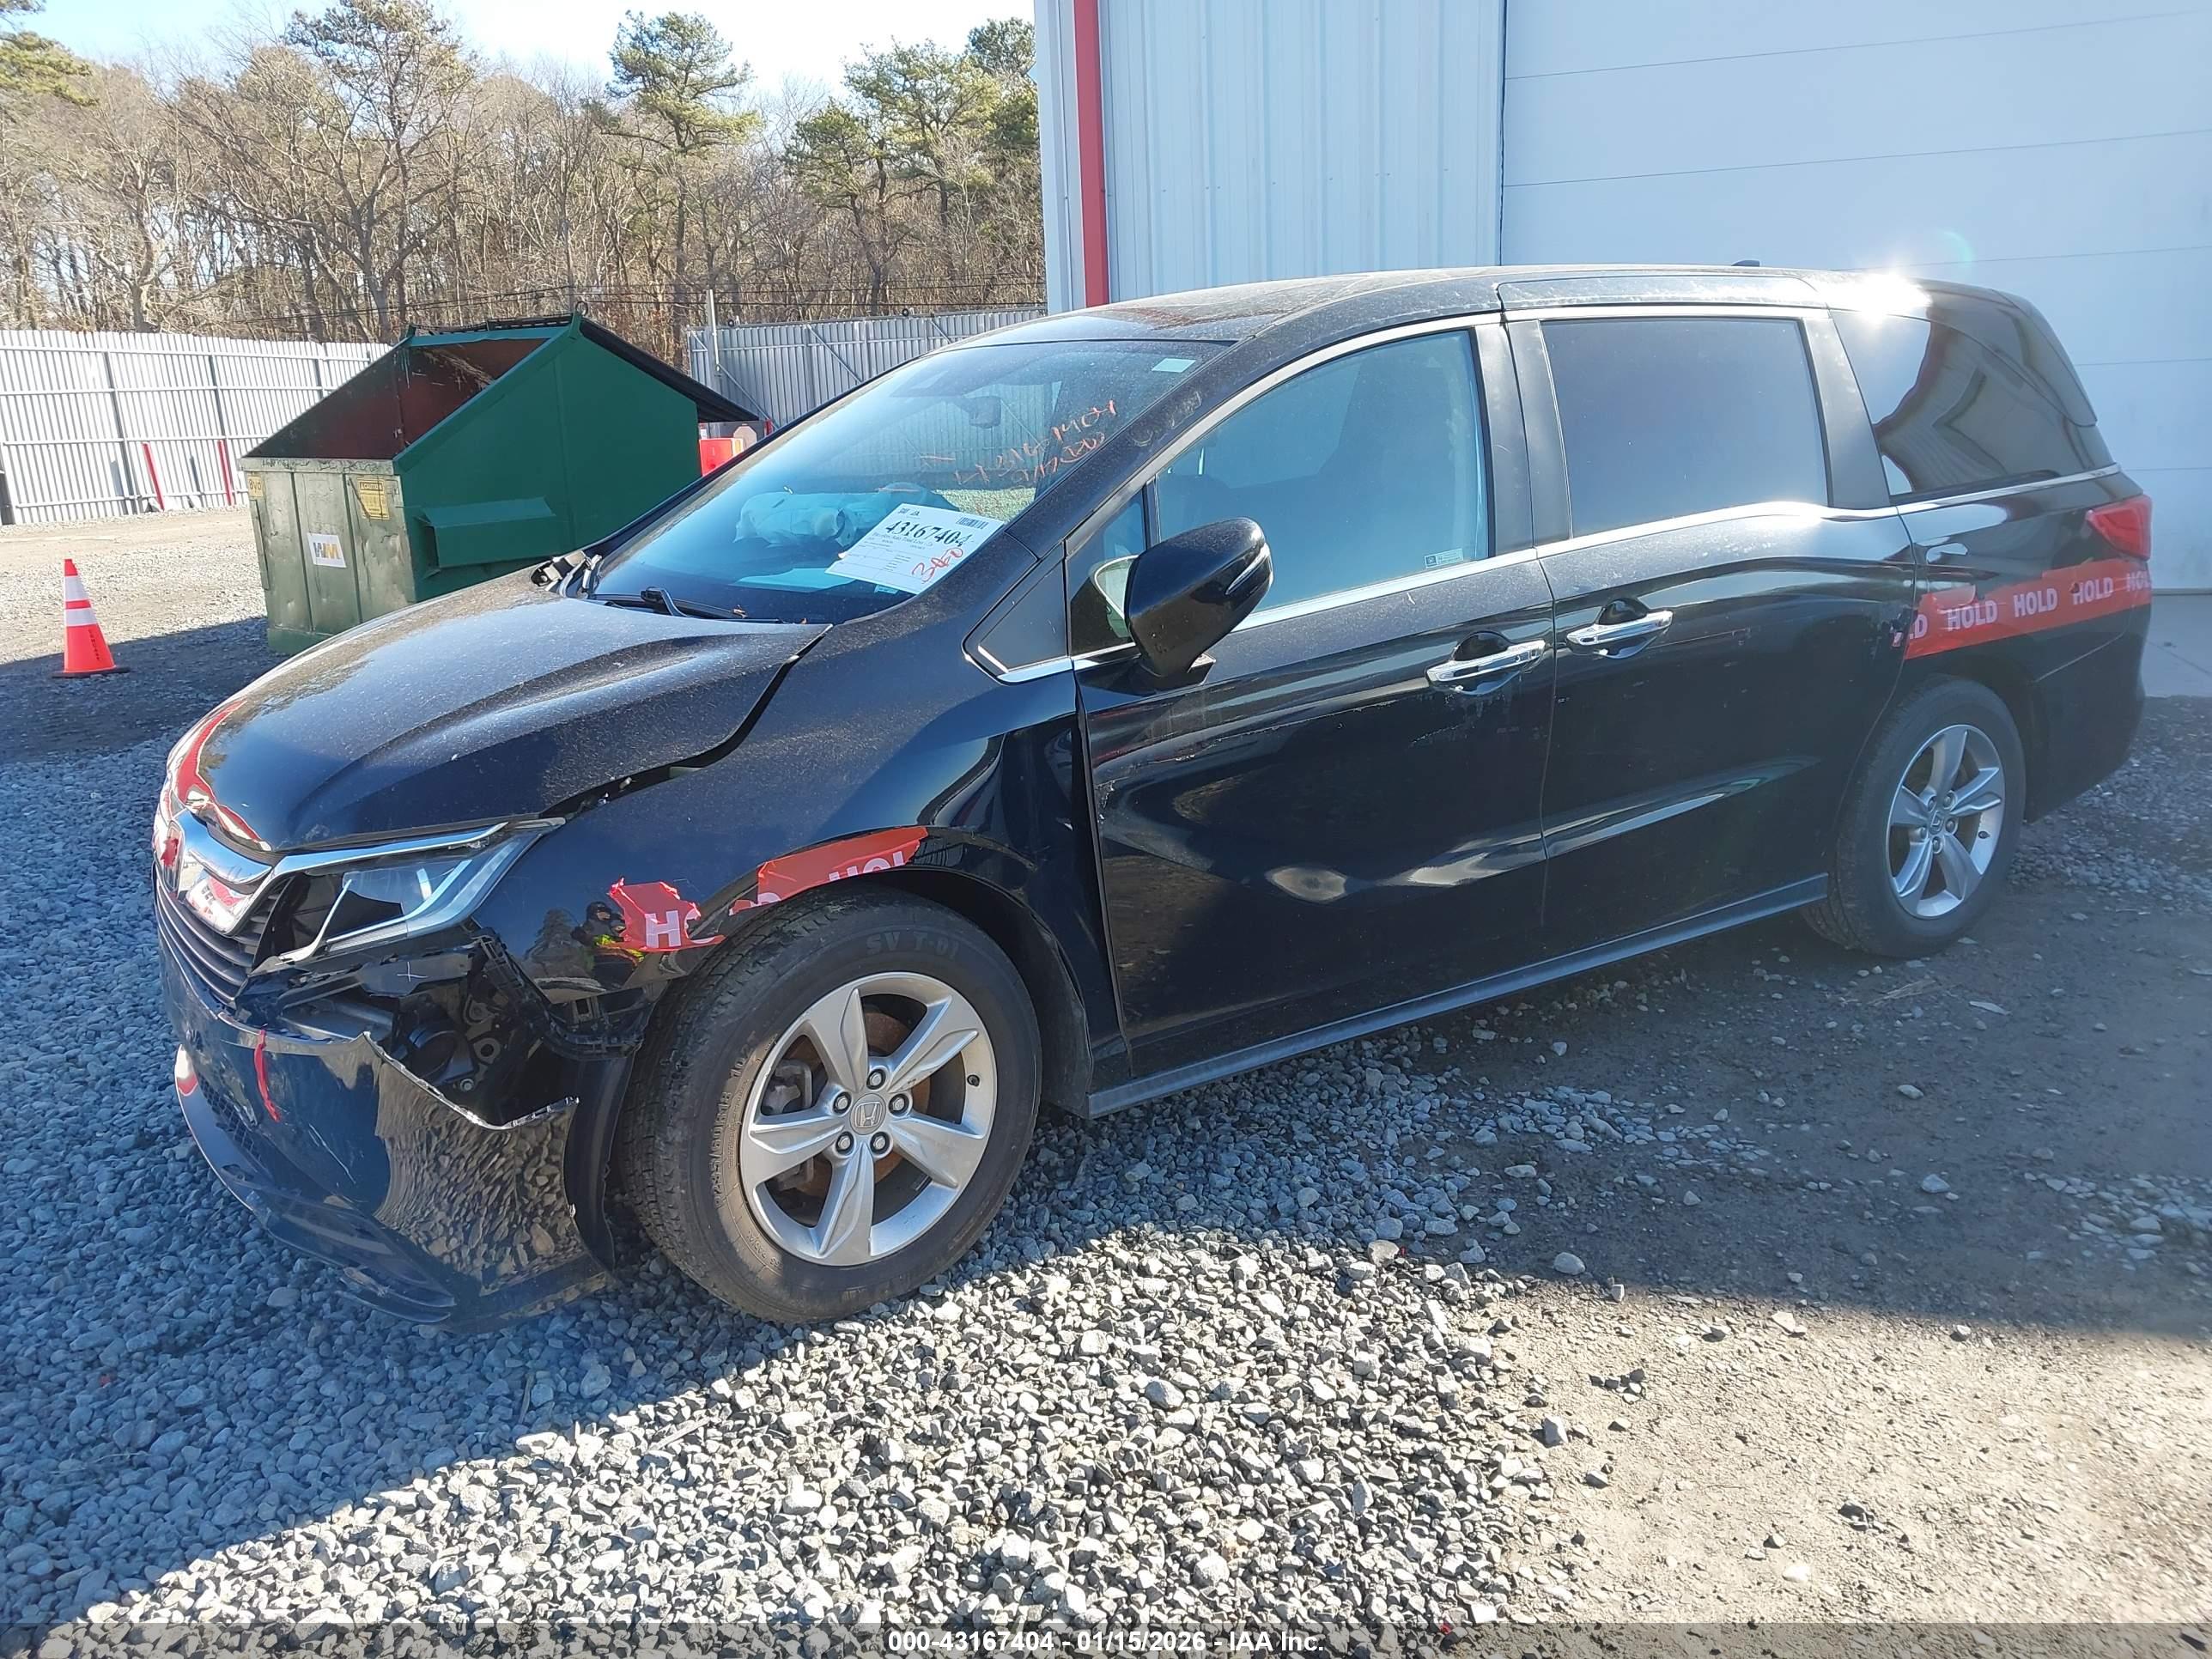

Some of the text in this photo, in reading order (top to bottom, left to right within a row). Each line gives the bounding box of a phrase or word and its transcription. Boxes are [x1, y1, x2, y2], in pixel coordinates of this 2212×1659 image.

[885, 520, 973, 548] 43167404
[1947, 599, 1998, 632] HOLD
[2012, 587, 2058, 618] HOLD
[2072, 577, 2114, 605] HOLD
